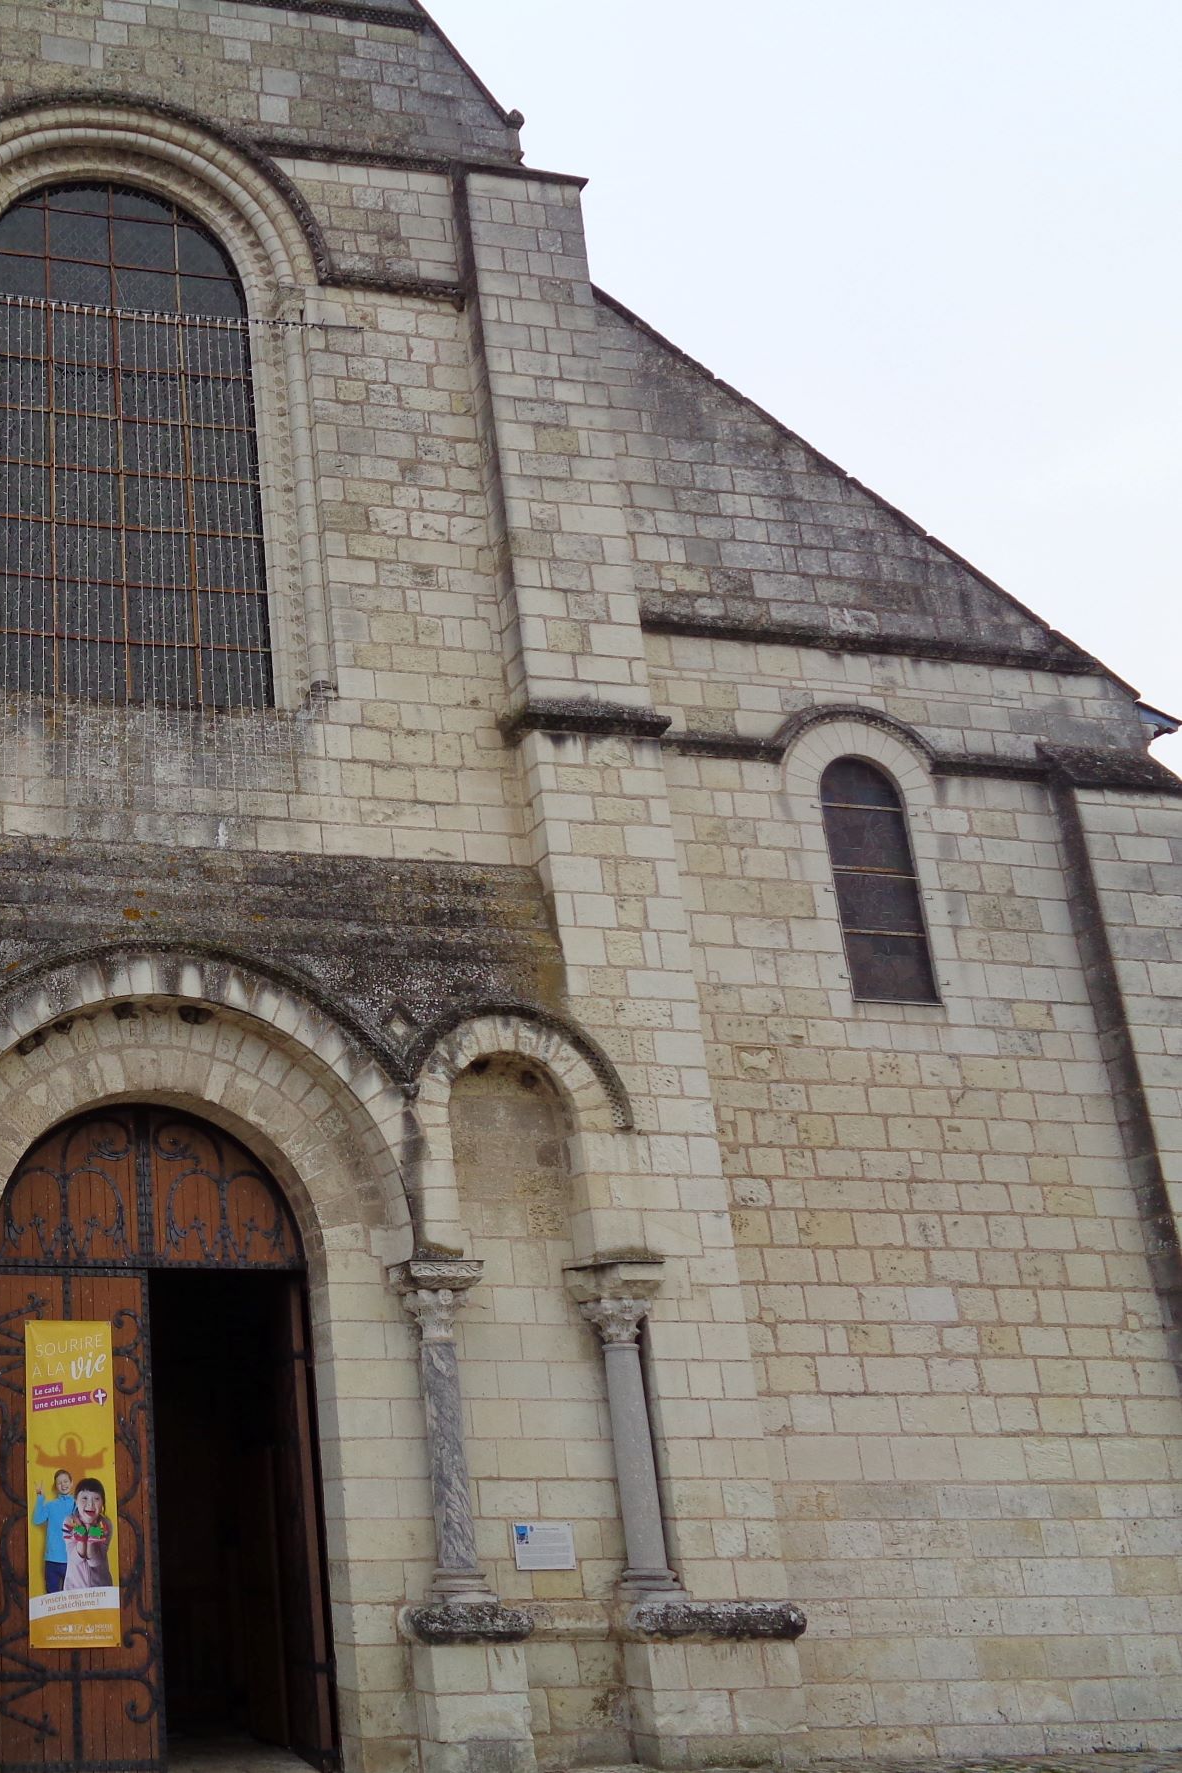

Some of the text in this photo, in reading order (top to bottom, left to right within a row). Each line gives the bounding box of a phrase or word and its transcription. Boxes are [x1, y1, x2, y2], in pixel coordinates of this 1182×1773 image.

[35, 1333, 105, 1358] SOURIRE
[47, 1361, 65, 1377] LA
[71, 1351, 107, 1380] vie
[34, 1388, 43, 1396] Le
[34, 1402, 49, 1410] une
[50, 1397, 76, 1407] chance
